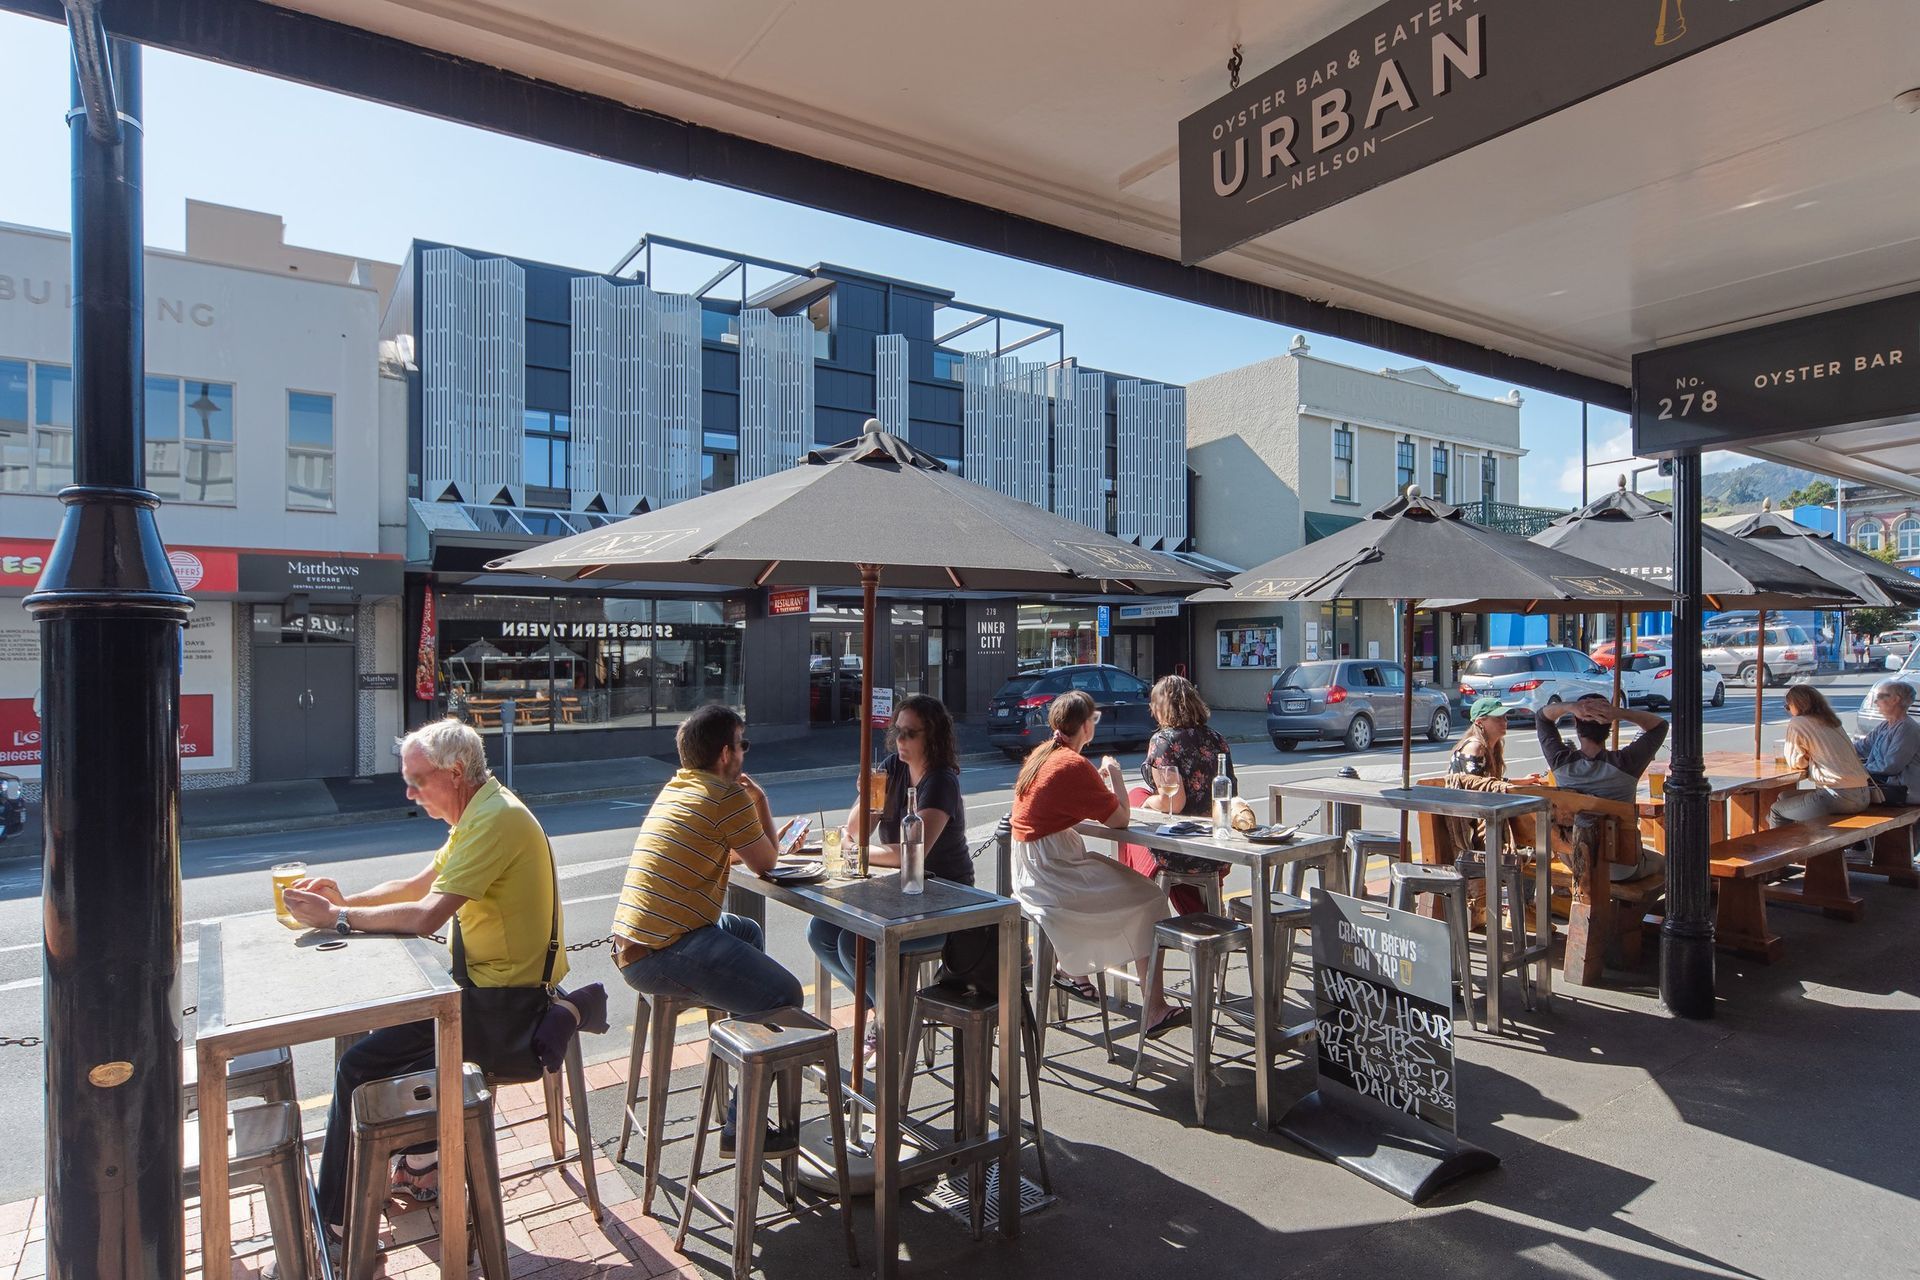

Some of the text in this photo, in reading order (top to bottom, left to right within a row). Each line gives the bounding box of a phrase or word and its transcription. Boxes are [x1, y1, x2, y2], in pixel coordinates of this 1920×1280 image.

[1212, 0, 1478, 141] OYSTER BAR & EATER
[1212, 13, 1487, 198] URBAN
[1291, 137, 1377, 190] NELSON
[1753, 350, 1904, 390] OYSTER BAR
[1657, 390, 1718, 421] 278
[287, 561, 360, 576] Matthews
[774, 596, 804, 609] RESTAURANT
[977, 621, 1005, 634] INNER
[981, 636, 1002, 649] CITY
[1338, 920, 1418, 962] CRAFTY BREWS
[1353, 945, 1398, 980] ON TAP
[1320, 968, 1454, 1048] HAPPY HOUR
[1338, 1009, 1436, 1065] OYSTERS
[1360, 1055, 1392, 1083] AND
